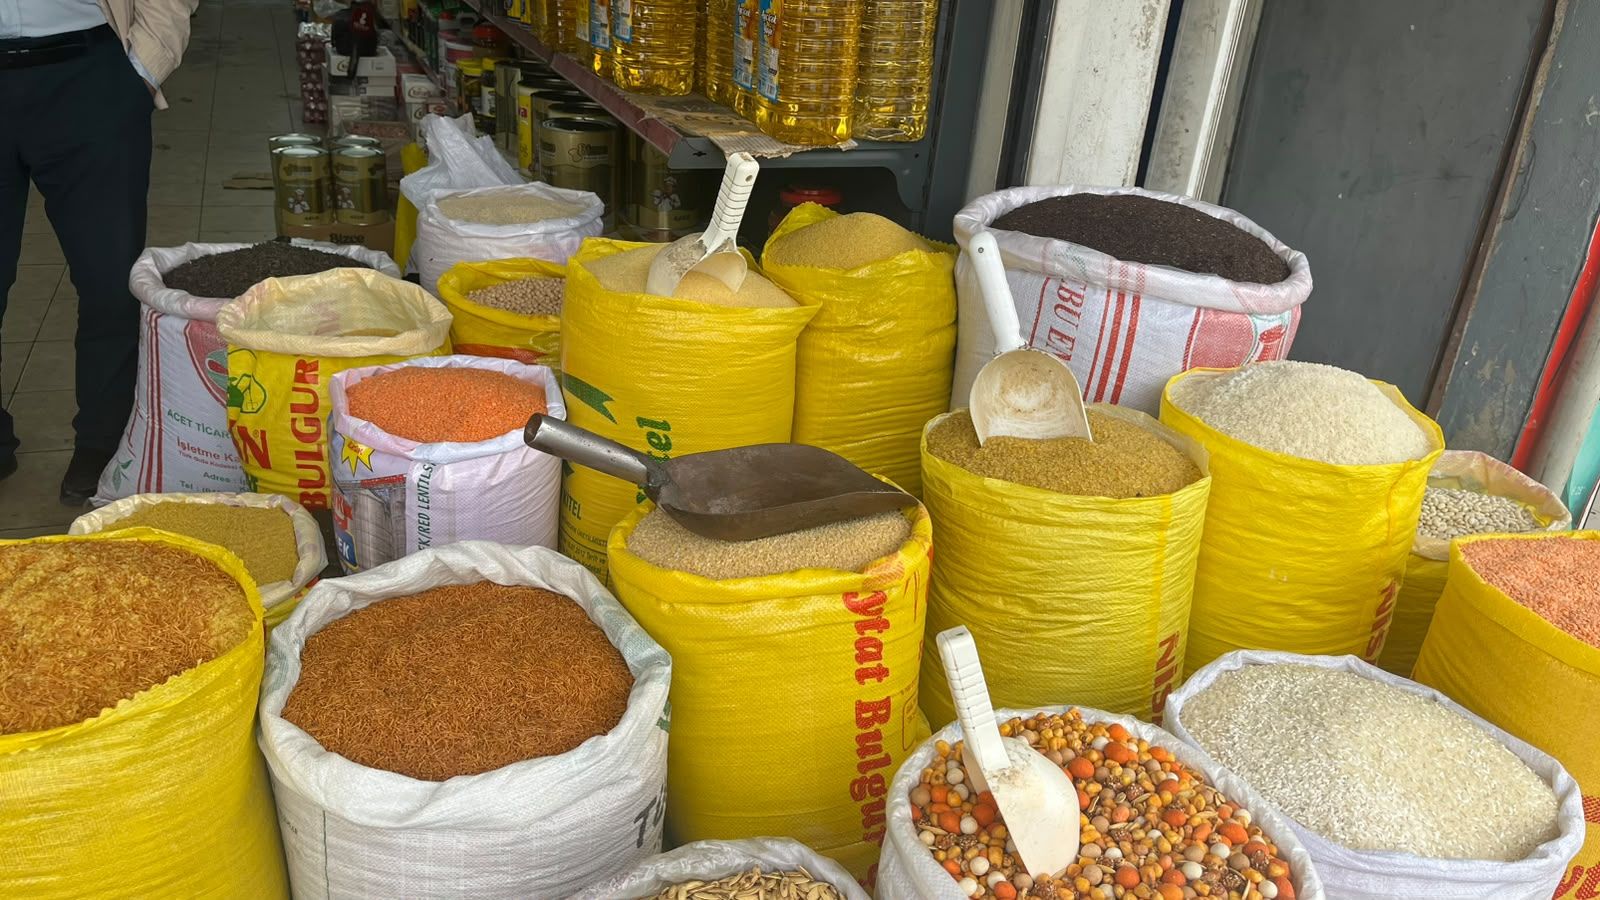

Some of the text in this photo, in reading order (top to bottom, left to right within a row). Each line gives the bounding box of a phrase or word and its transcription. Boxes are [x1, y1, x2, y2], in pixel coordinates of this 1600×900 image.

[167, 409, 193, 427] ACET
[290, 359, 328, 511] BULGUR
[850, 696, 892, 848] Bulgur
